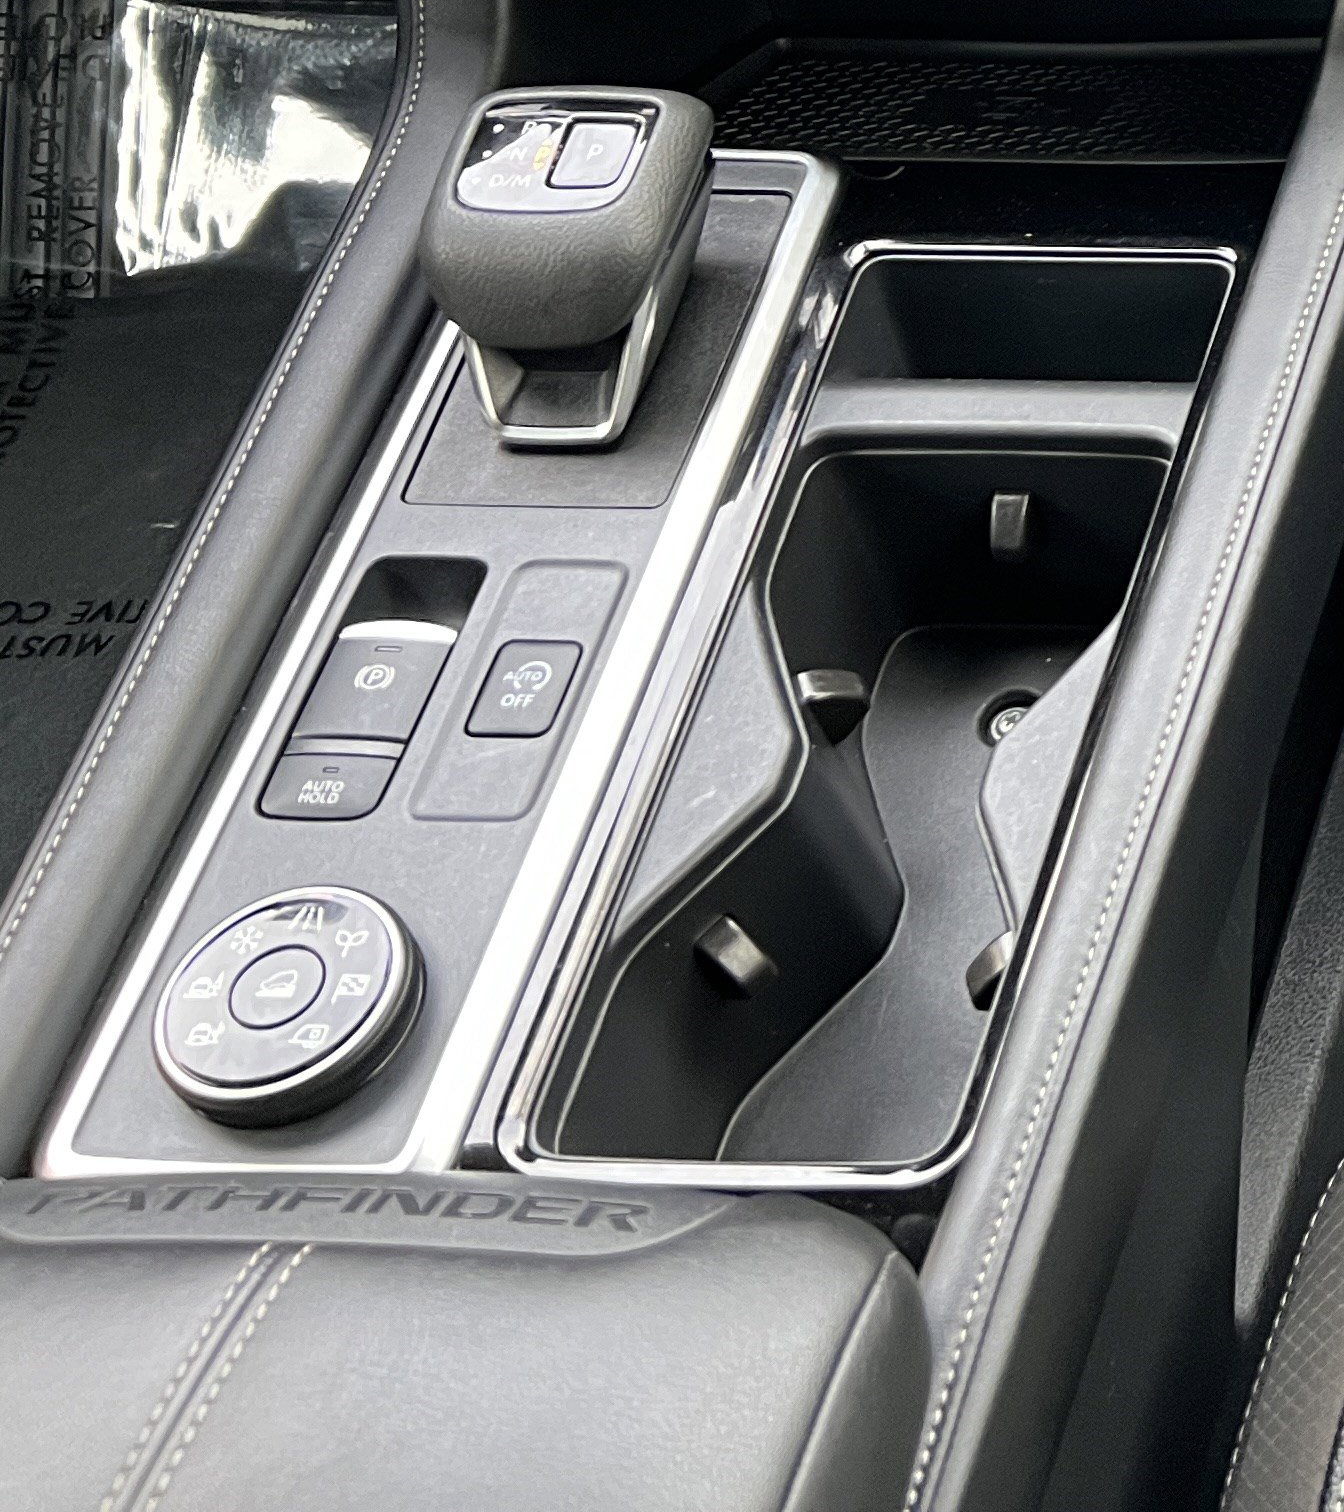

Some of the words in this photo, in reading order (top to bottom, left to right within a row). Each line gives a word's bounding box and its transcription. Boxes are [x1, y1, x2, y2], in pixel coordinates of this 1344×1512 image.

[509, 147, 528, 161] N
[586, 144, 604, 160] P
[488, 174, 532, 189] D/M
[500, 692, 535, 708] OFF
[302, 780, 346, 795] AUTO
[297, 790, 340, 805] HOLD
[28, 1182, 654, 1233] PATHFINDER
